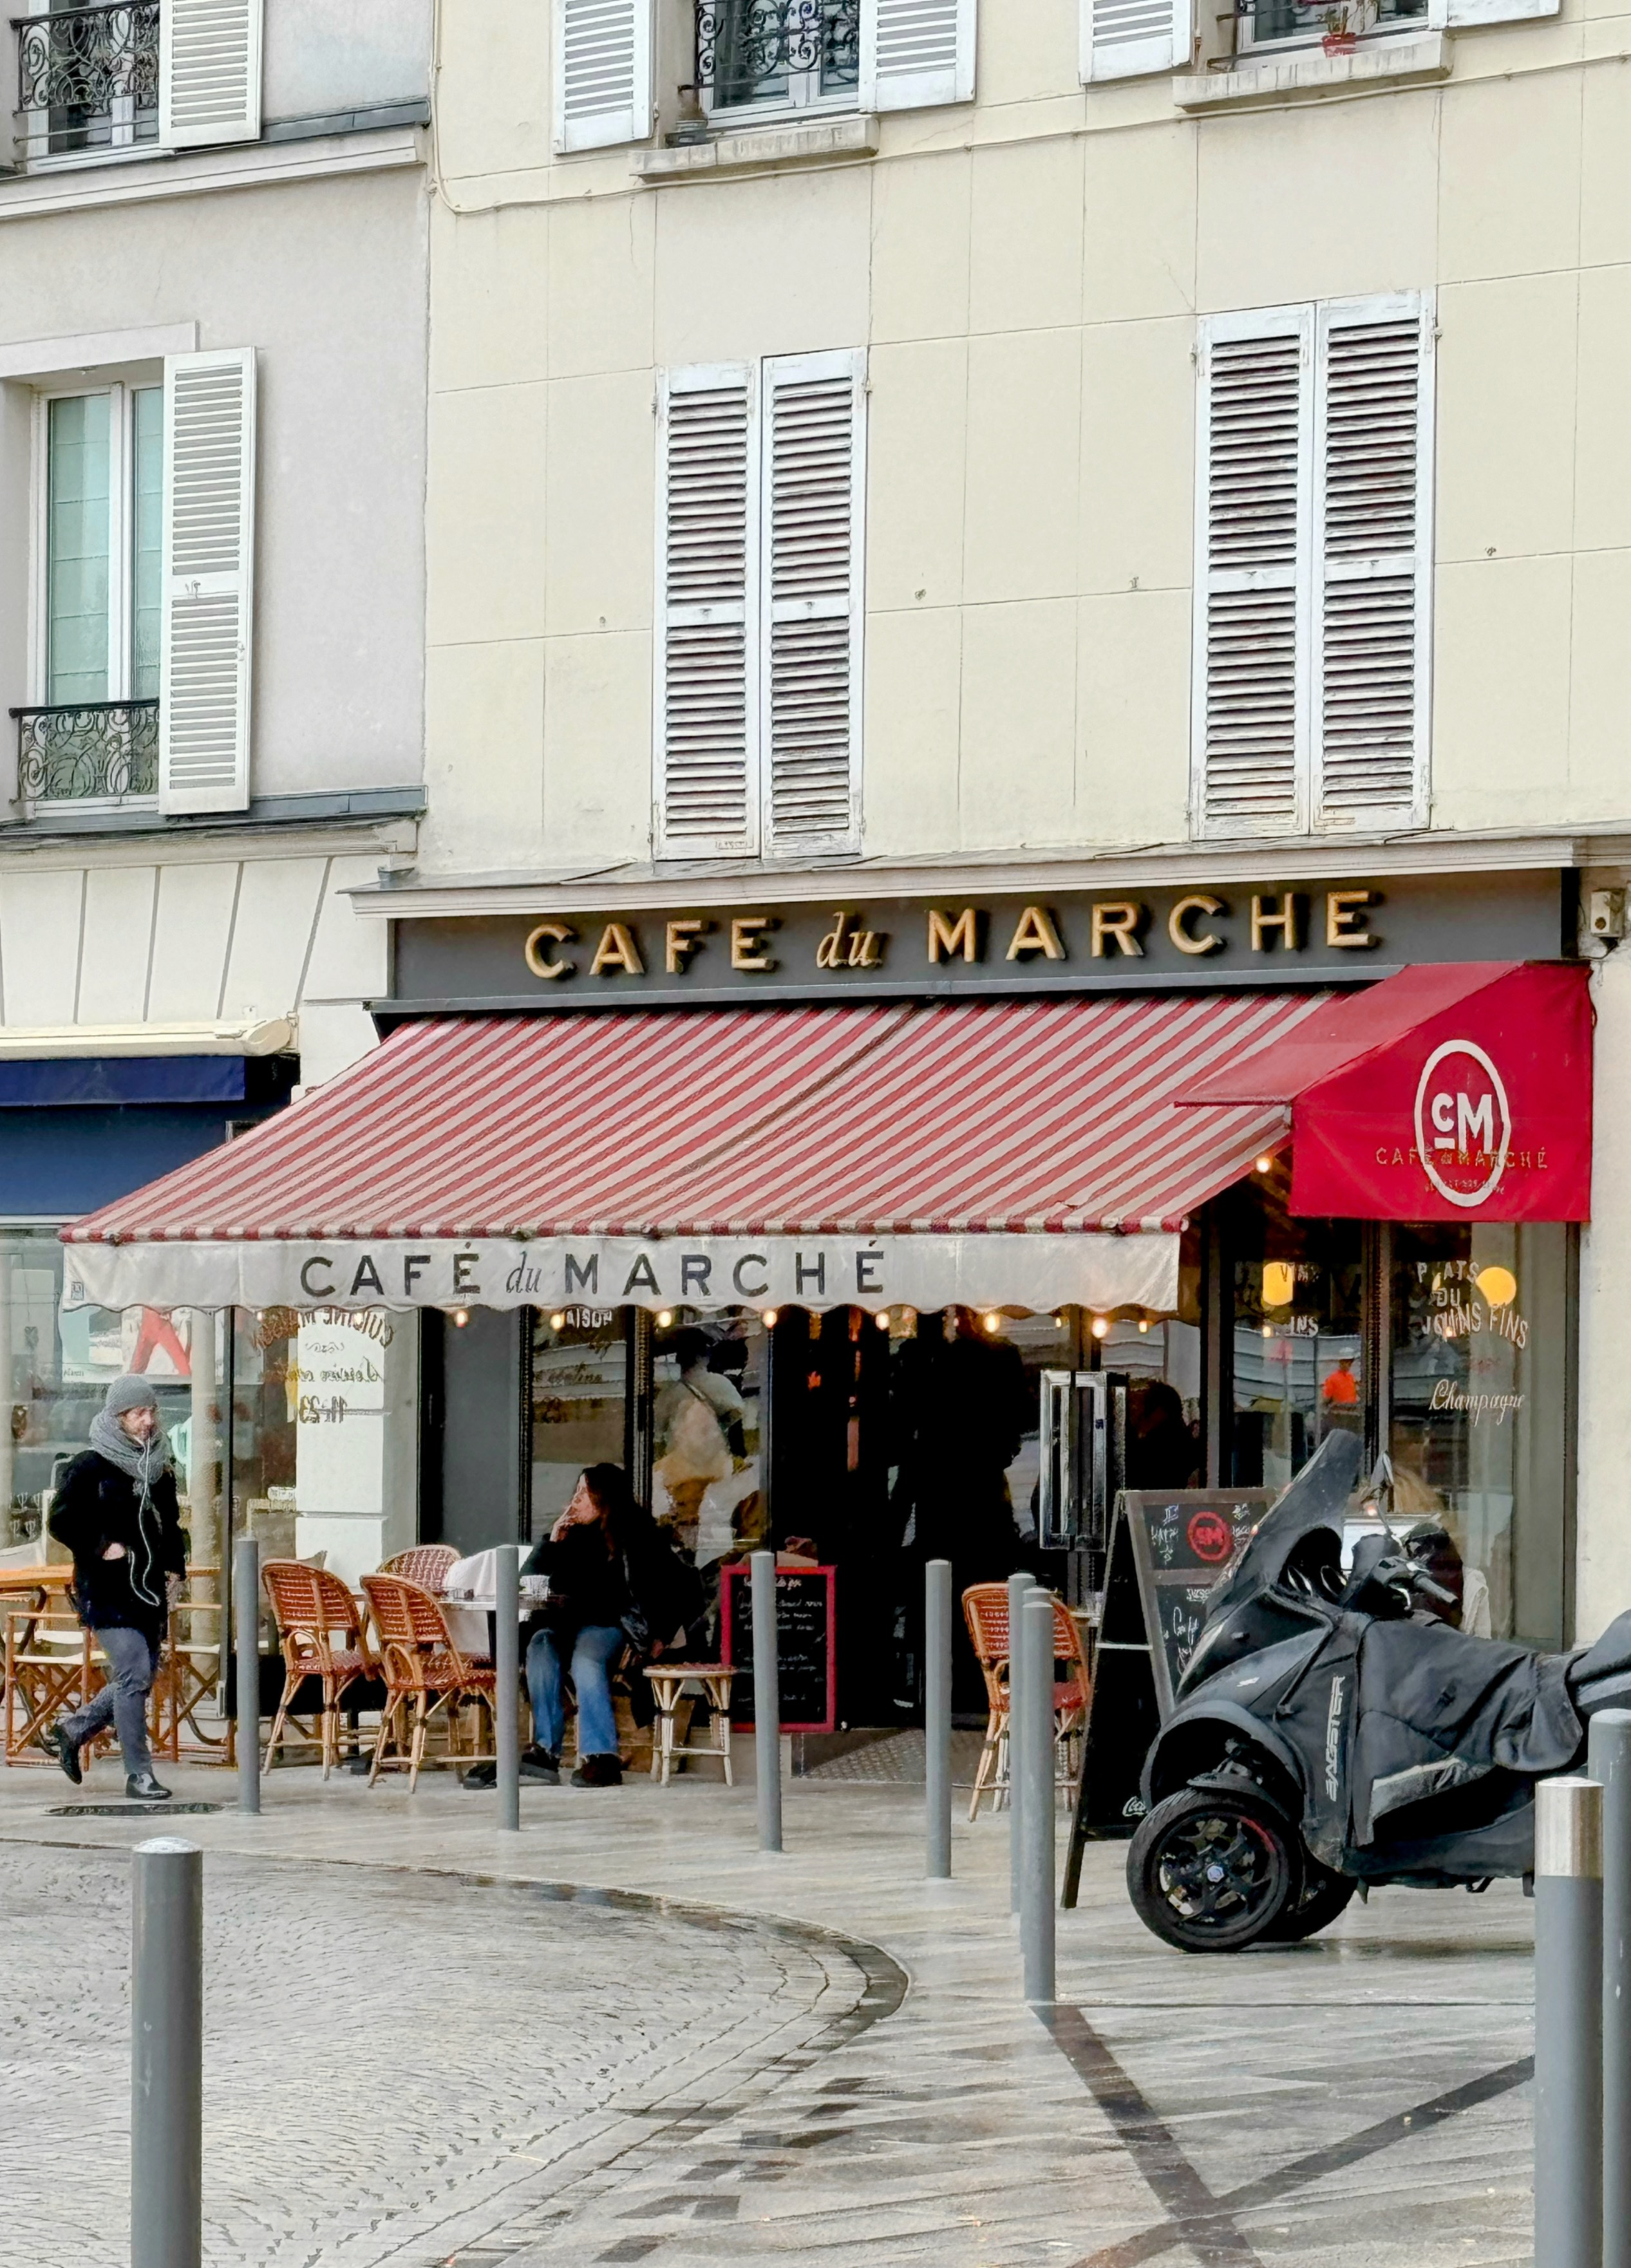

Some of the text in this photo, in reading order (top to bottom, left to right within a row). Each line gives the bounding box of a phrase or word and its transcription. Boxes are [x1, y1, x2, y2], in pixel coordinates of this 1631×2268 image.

[525, 890, 1379, 979] CAFE du MARCHE
[300, 1240, 884, 1298] CAFÉ du MARCHÉ
[1429, 1378, 1525, 1427] Champagne
